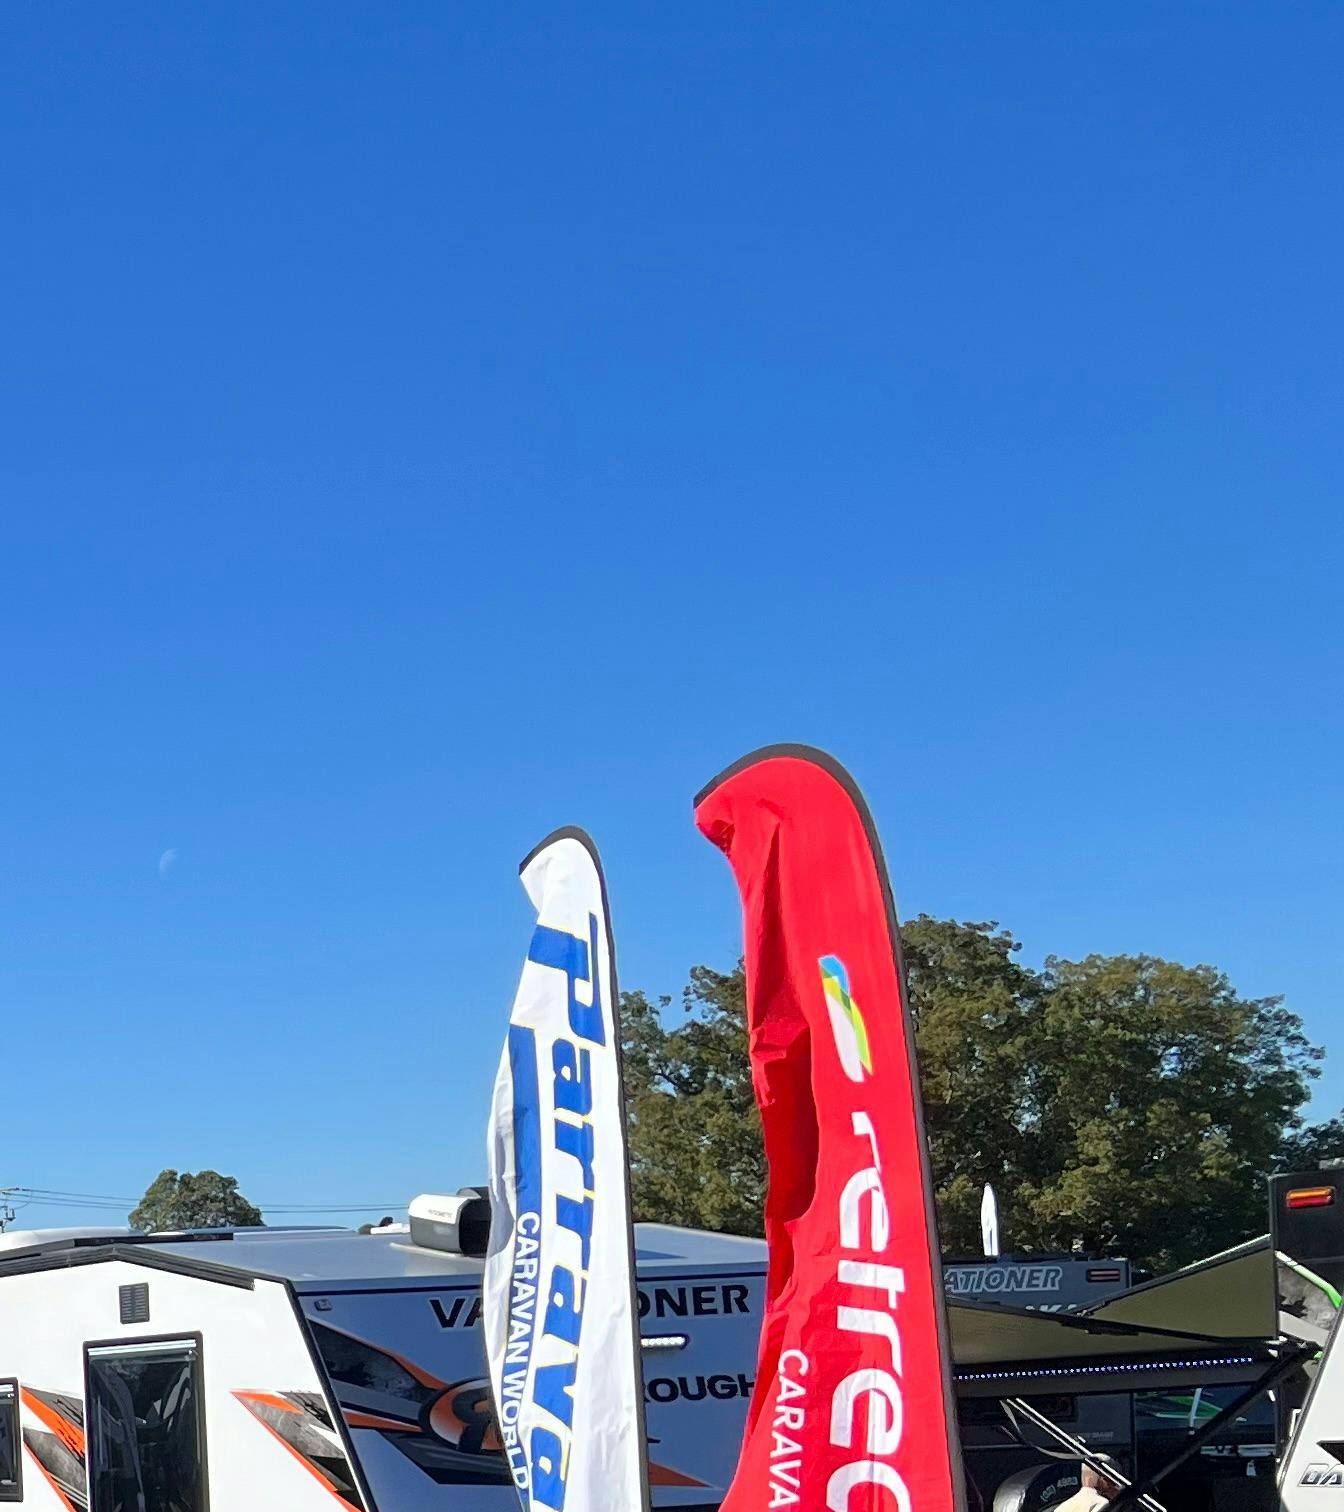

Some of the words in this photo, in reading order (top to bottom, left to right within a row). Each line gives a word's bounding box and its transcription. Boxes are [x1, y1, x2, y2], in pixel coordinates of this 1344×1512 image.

[504, 1212, 541, 1371] CARAVAN
[945, 1266, 1062, 1293] ATIONER
[501, 1373, 529, 1490] WORLD
